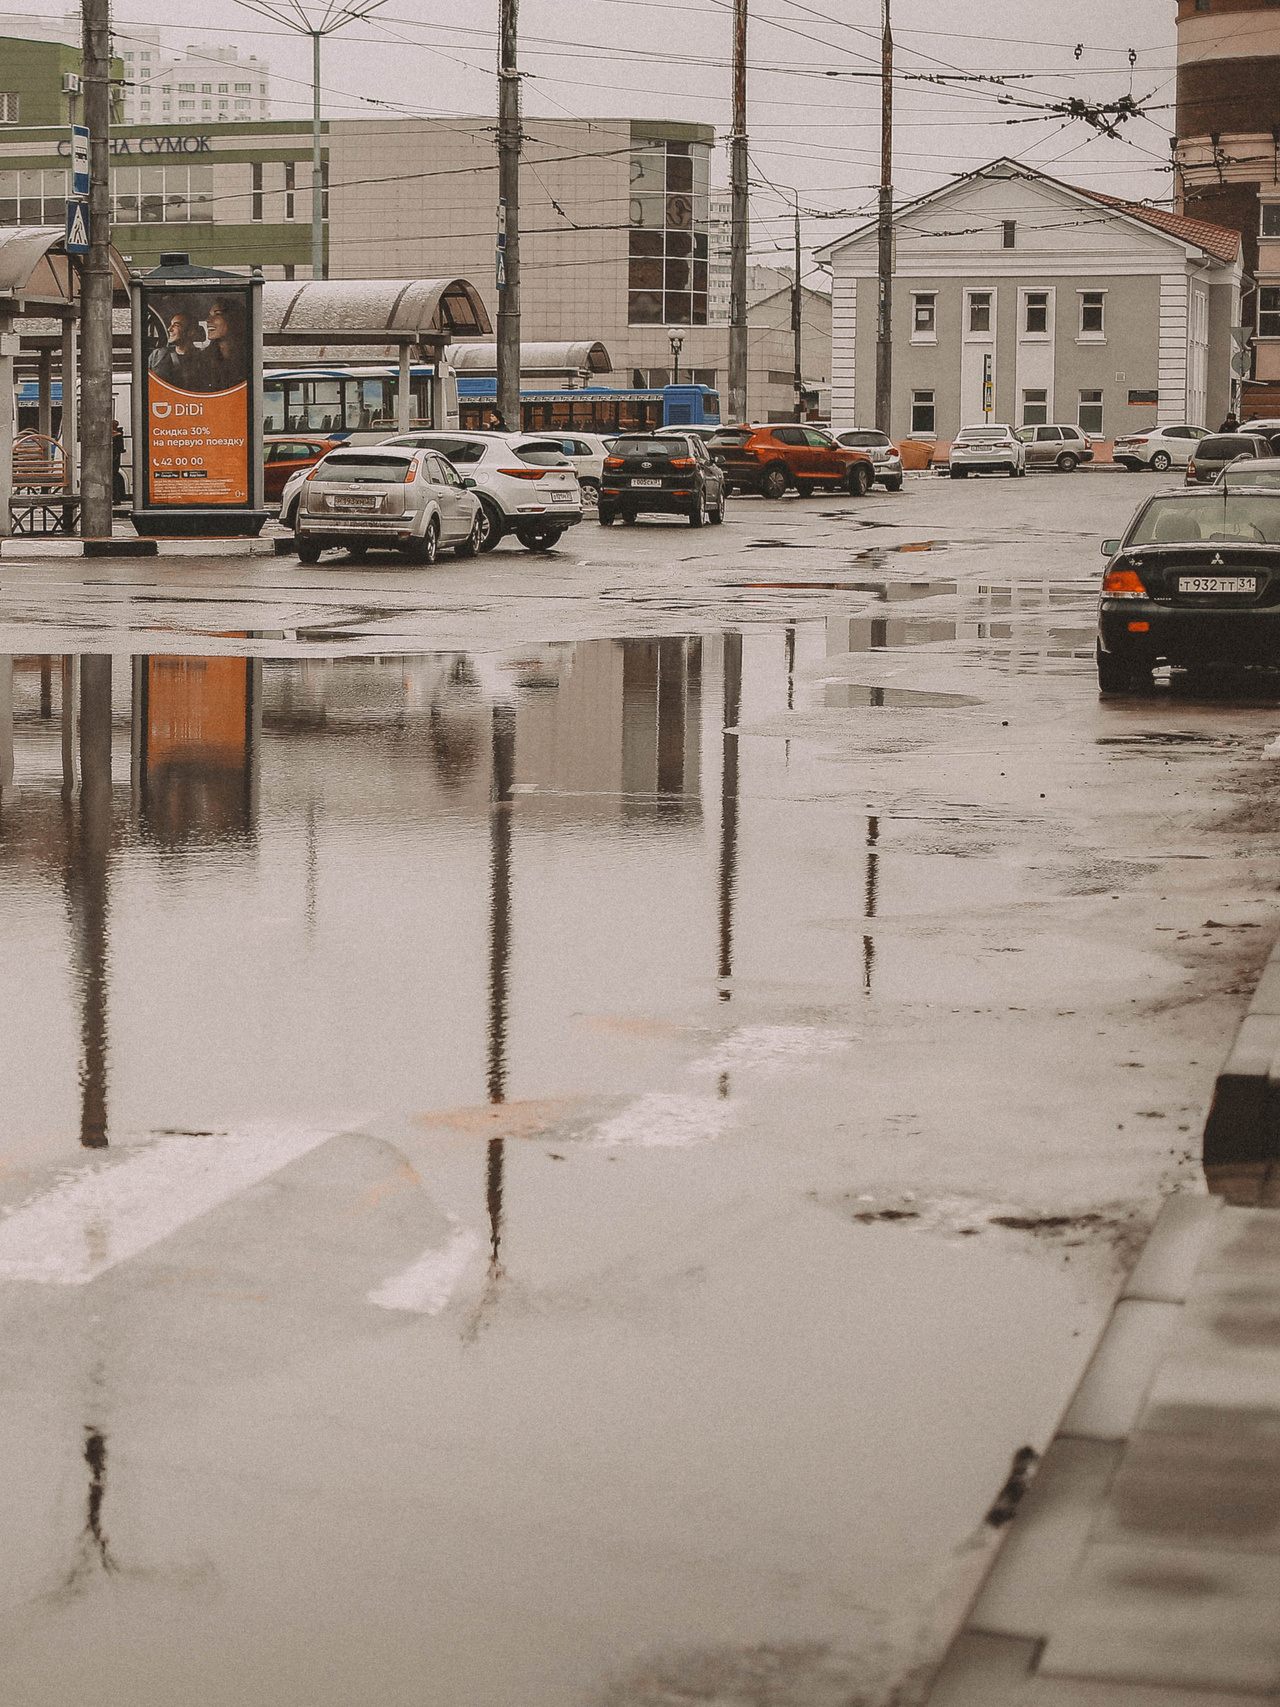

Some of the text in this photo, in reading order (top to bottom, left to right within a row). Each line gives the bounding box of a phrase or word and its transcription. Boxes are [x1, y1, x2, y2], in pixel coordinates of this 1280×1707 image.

[139, 135, 211, 155] СУМОК
[175, 403, 203, 416] DiDi
[153, 427, 210, 436] Скидка 30%
[167, 439, 203, 447] первую
[206, 438, 244, 446] поездку
[161, 457, 204, 466] 42 00 00
[1239, 579, 1252, 588] 31
